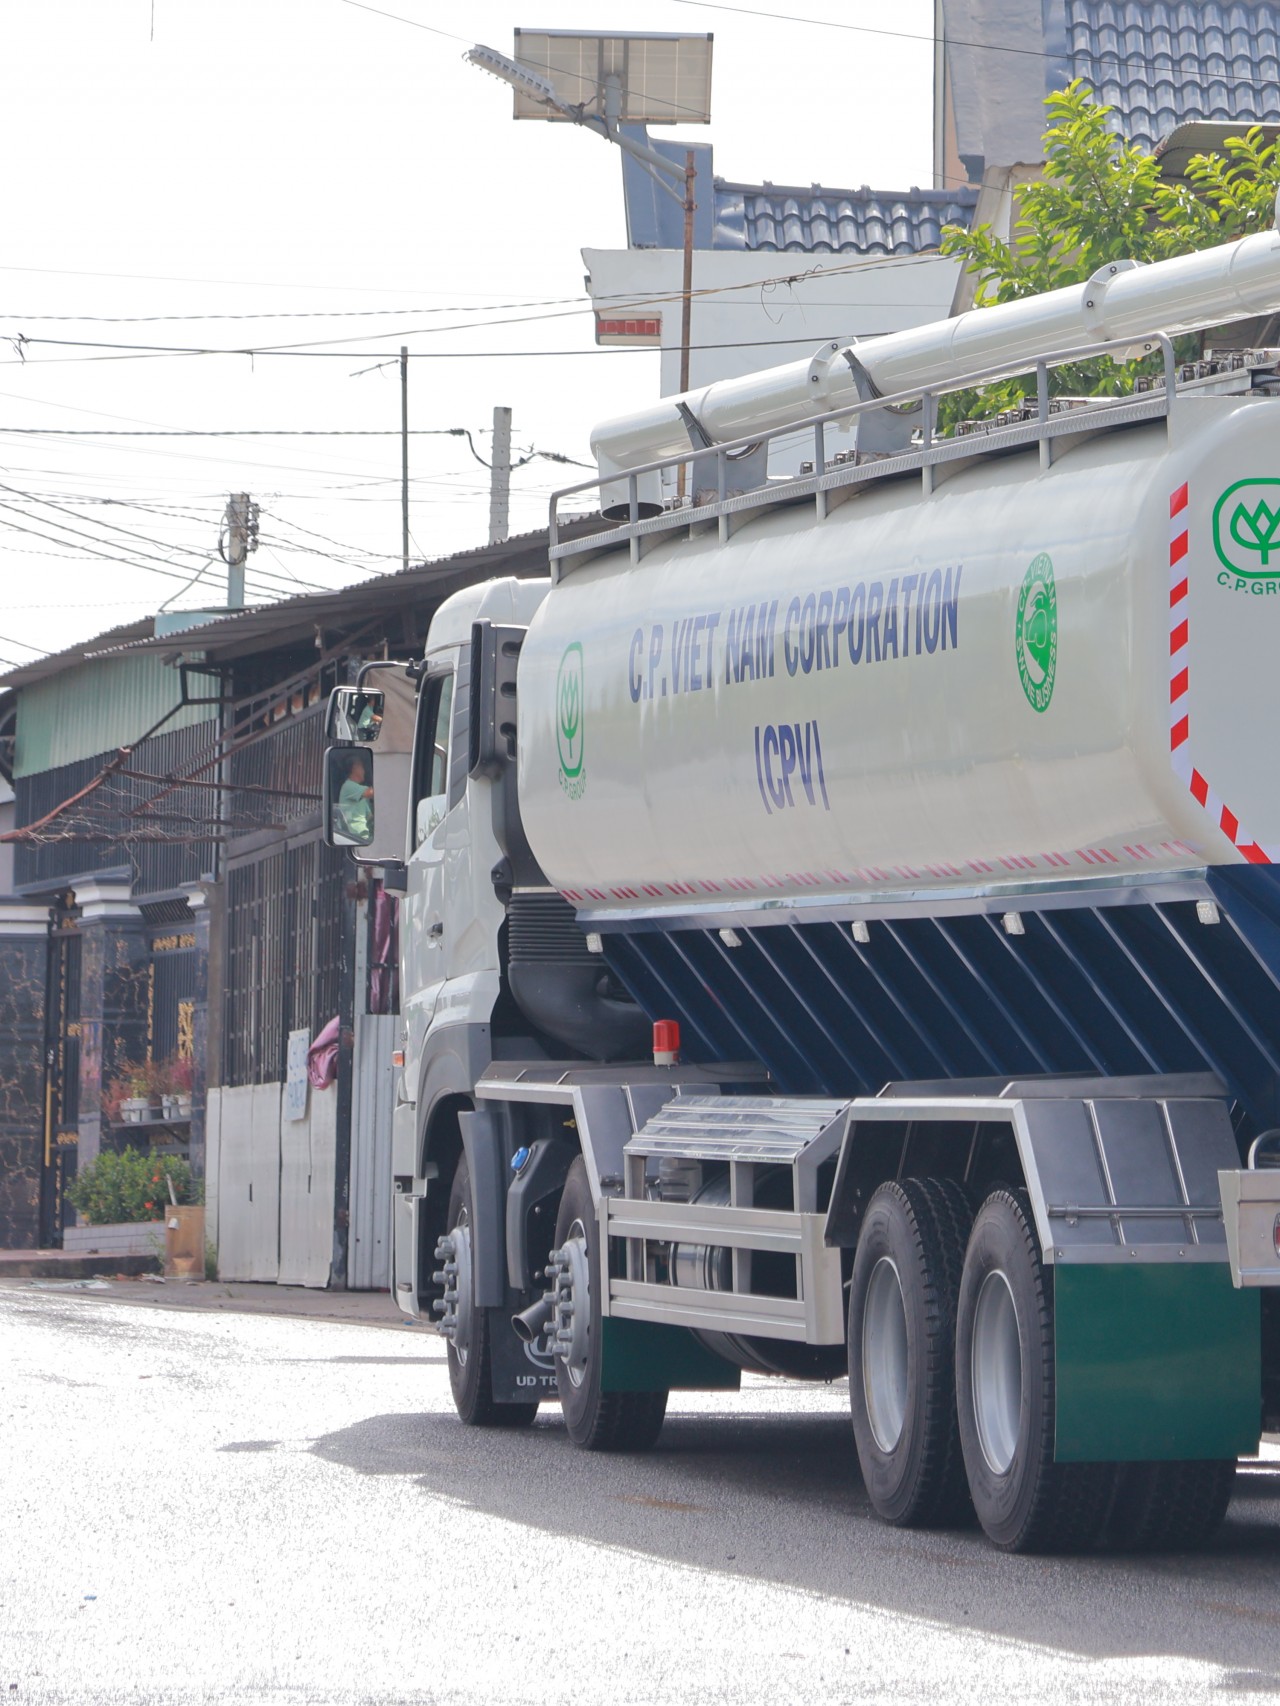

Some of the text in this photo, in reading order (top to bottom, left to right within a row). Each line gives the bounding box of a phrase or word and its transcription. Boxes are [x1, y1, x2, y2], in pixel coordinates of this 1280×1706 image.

[725, 599, 779, 685] NAM
[784, 565, 963, 678] CORPORATION
[1035, 633, 1057, 708] BUSINESS
[754, 719, 831, 815] (CPV)
[516, 1375, 537, 1387] UD
